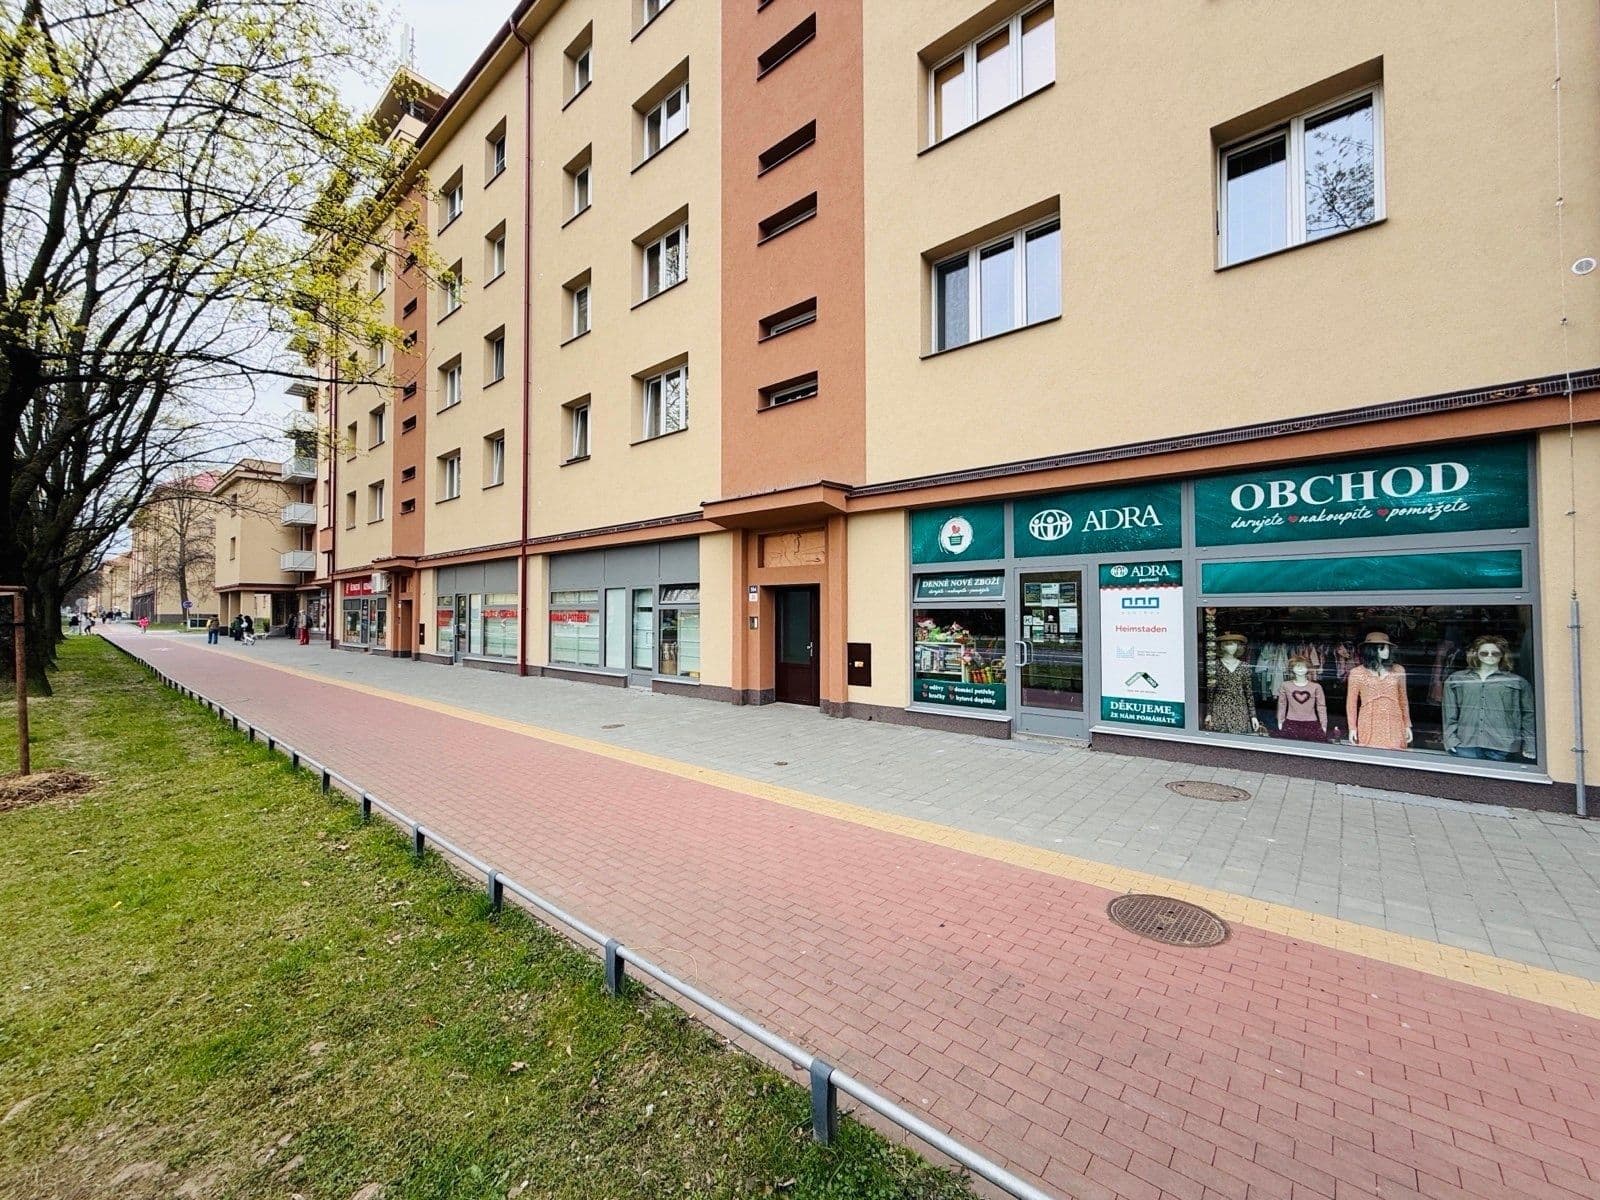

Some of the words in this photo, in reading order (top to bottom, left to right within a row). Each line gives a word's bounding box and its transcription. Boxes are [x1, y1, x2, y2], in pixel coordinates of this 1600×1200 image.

[1231, 462, 1470, 511] OBCHOD
[1082, 505, 1162, 533] ADRA
[1231, 513, 1285, 533] darujete
[1299, 505, 1373, 526] nakoupíte
[1385, 498, 1470, 522] pomůžete
[1130, 564, 1170, 577] ADRA
[922, 579, 949, 588] DENNĚ
[951, 578, 972, 587] NOVÉ
[974, 576, 1000, 586] ZBOŽÍ
[1115, 625, 1168, 633] Heimstaden
[1110, 699, 1176, 716] DĚKUJEME,
[1120, 712, 1135, 720] NÁM
[1136, 714, 1176, 724] POMÁHÁTE
